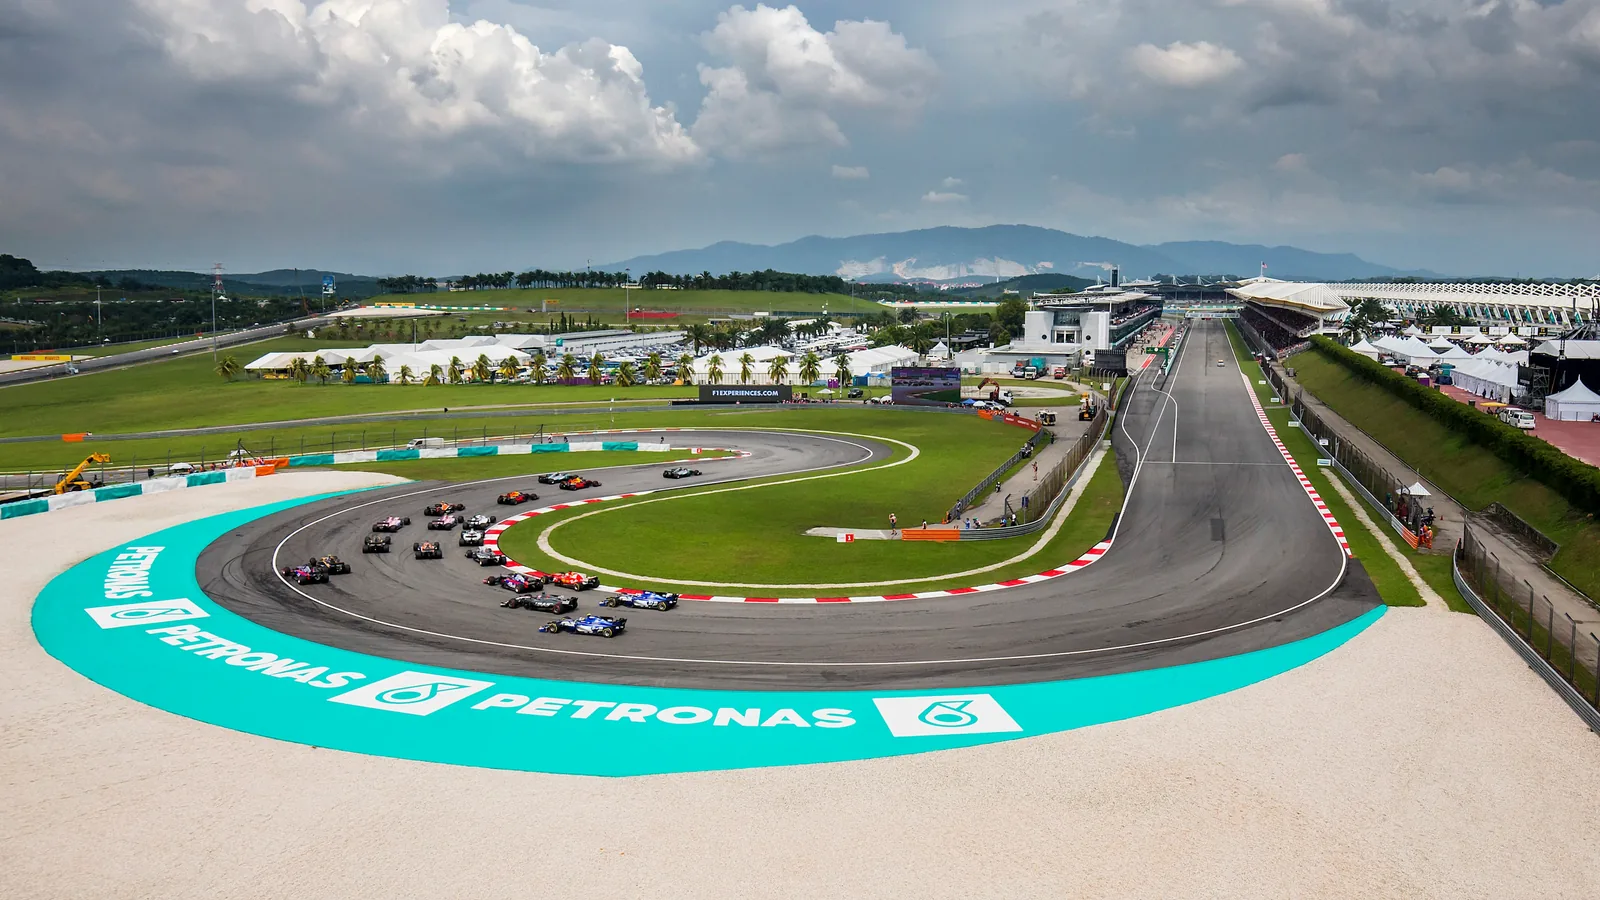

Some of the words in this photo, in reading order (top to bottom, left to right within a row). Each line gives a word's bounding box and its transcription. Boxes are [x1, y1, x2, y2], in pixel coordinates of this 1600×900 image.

[104, 546, 165, 599] PETRONAS
[145, 624, 367, 689] PETRONAS
[471, 693, 857, 729] PETRONAS
